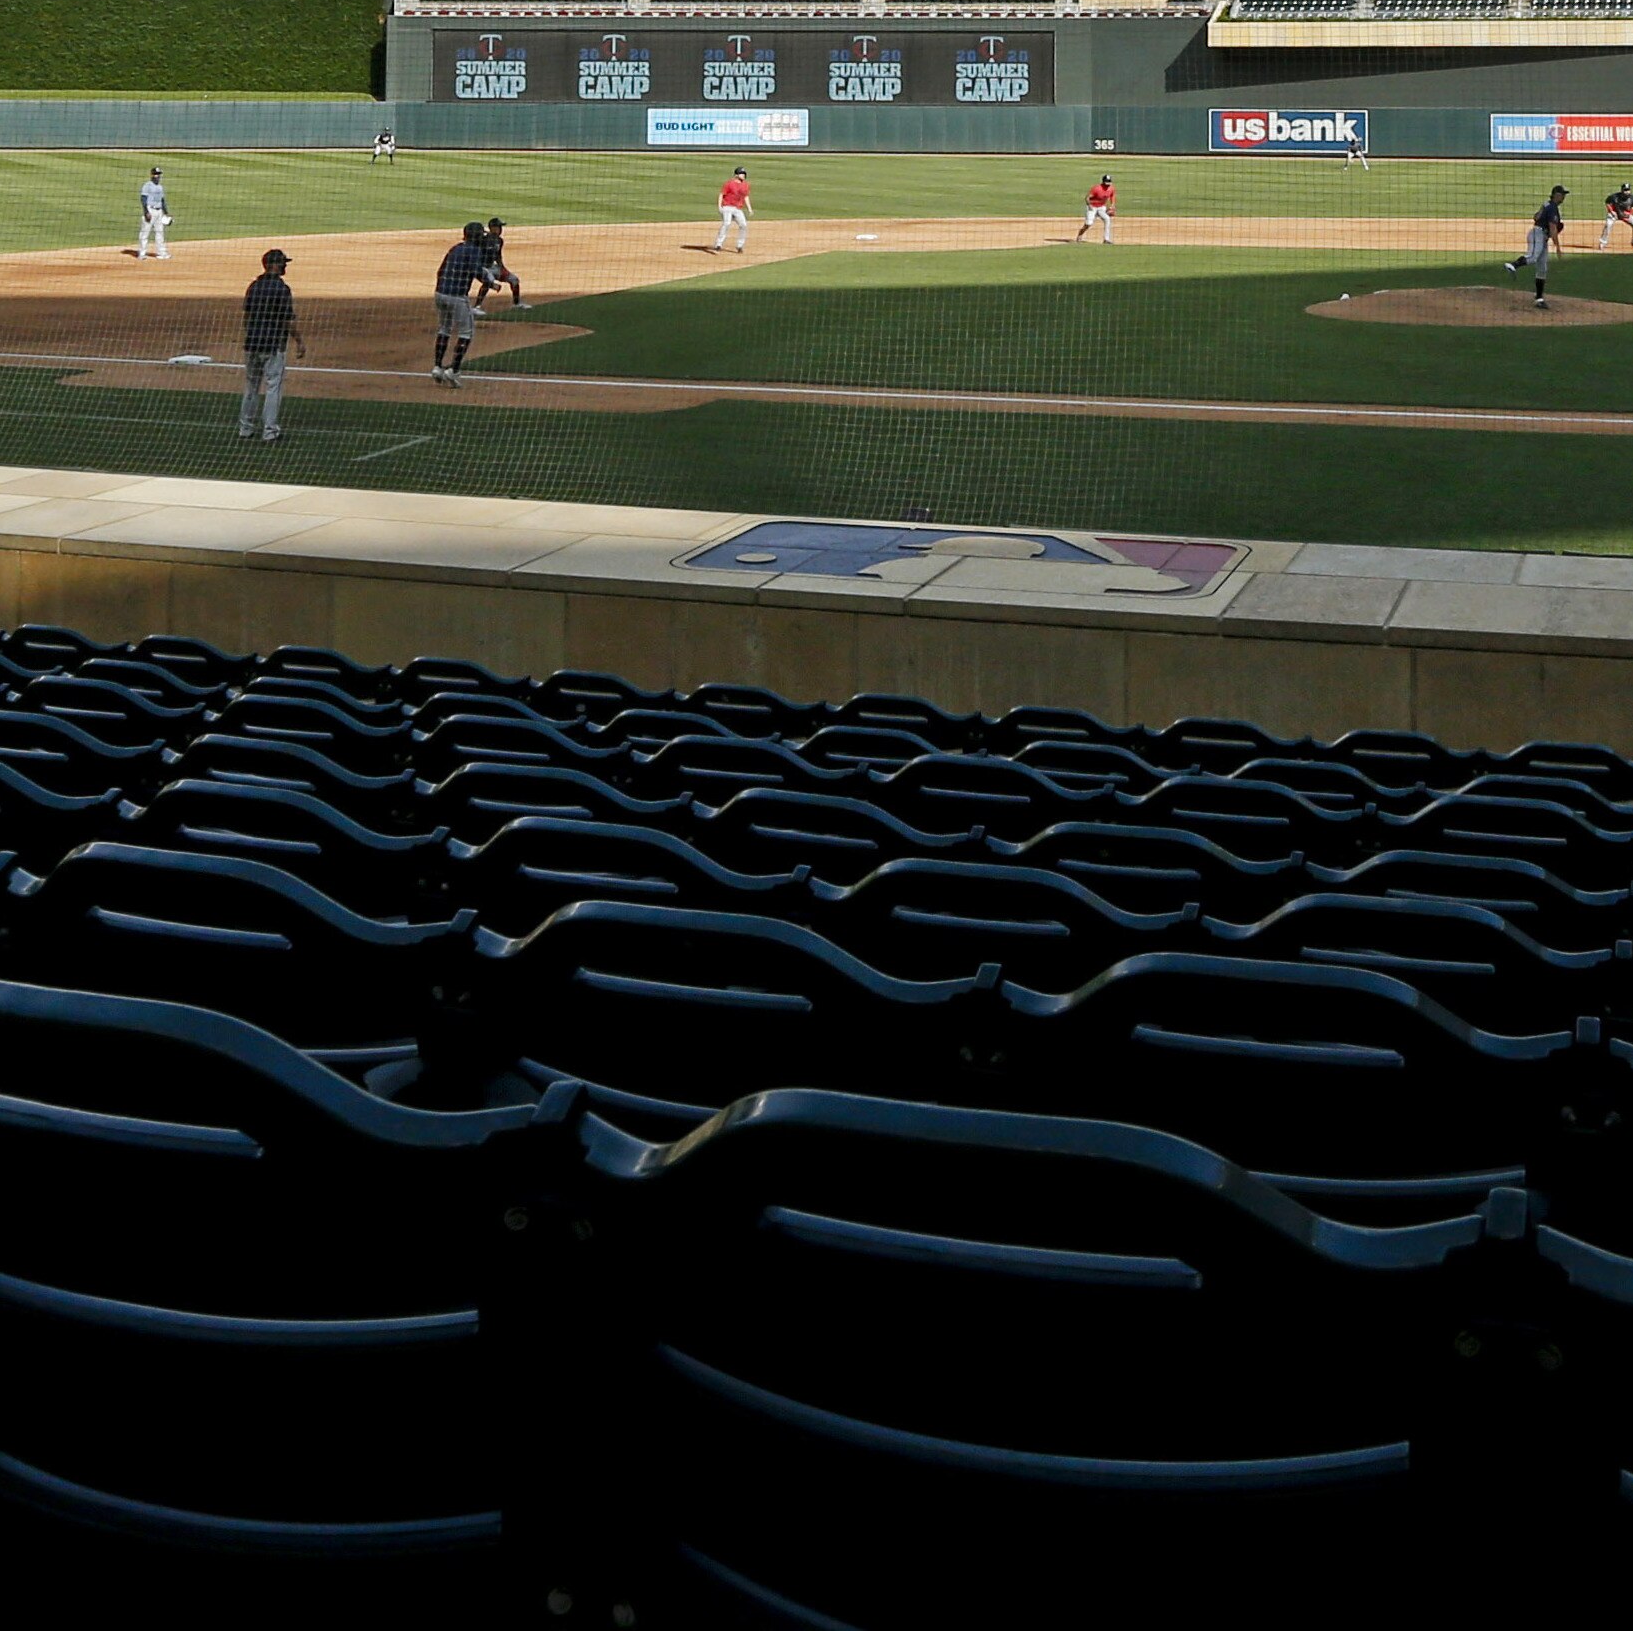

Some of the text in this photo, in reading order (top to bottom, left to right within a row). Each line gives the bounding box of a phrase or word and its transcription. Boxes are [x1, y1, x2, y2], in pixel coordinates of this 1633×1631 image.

[455, 60, 526, 75] SUMMER
[579, 61, 650, 76] SUMMER
[704, 62, 775, 76] SUMMER
[829, 63, 902, 77] SUMMER
[956, 63, 1029, 77] SUMMER
[455, 75, 526, 98] CAMP
[579, 76, 650, 99] CAMP
[704, 77, 775, 100] CAMP
[829, 78, 902, 101] CAMP
[956, 78, 1029, 102] CAMP
[655, 122, 679, 131] BUD
[681, 122, 715, 131] LIGHT
[1498, 126, 1527, 141] THANK
[1528, 126, 1546, 141] YOU
[1568, 126, 1615, 142] ESSENTIAL
[1094, 139, 1115, 150] 365
